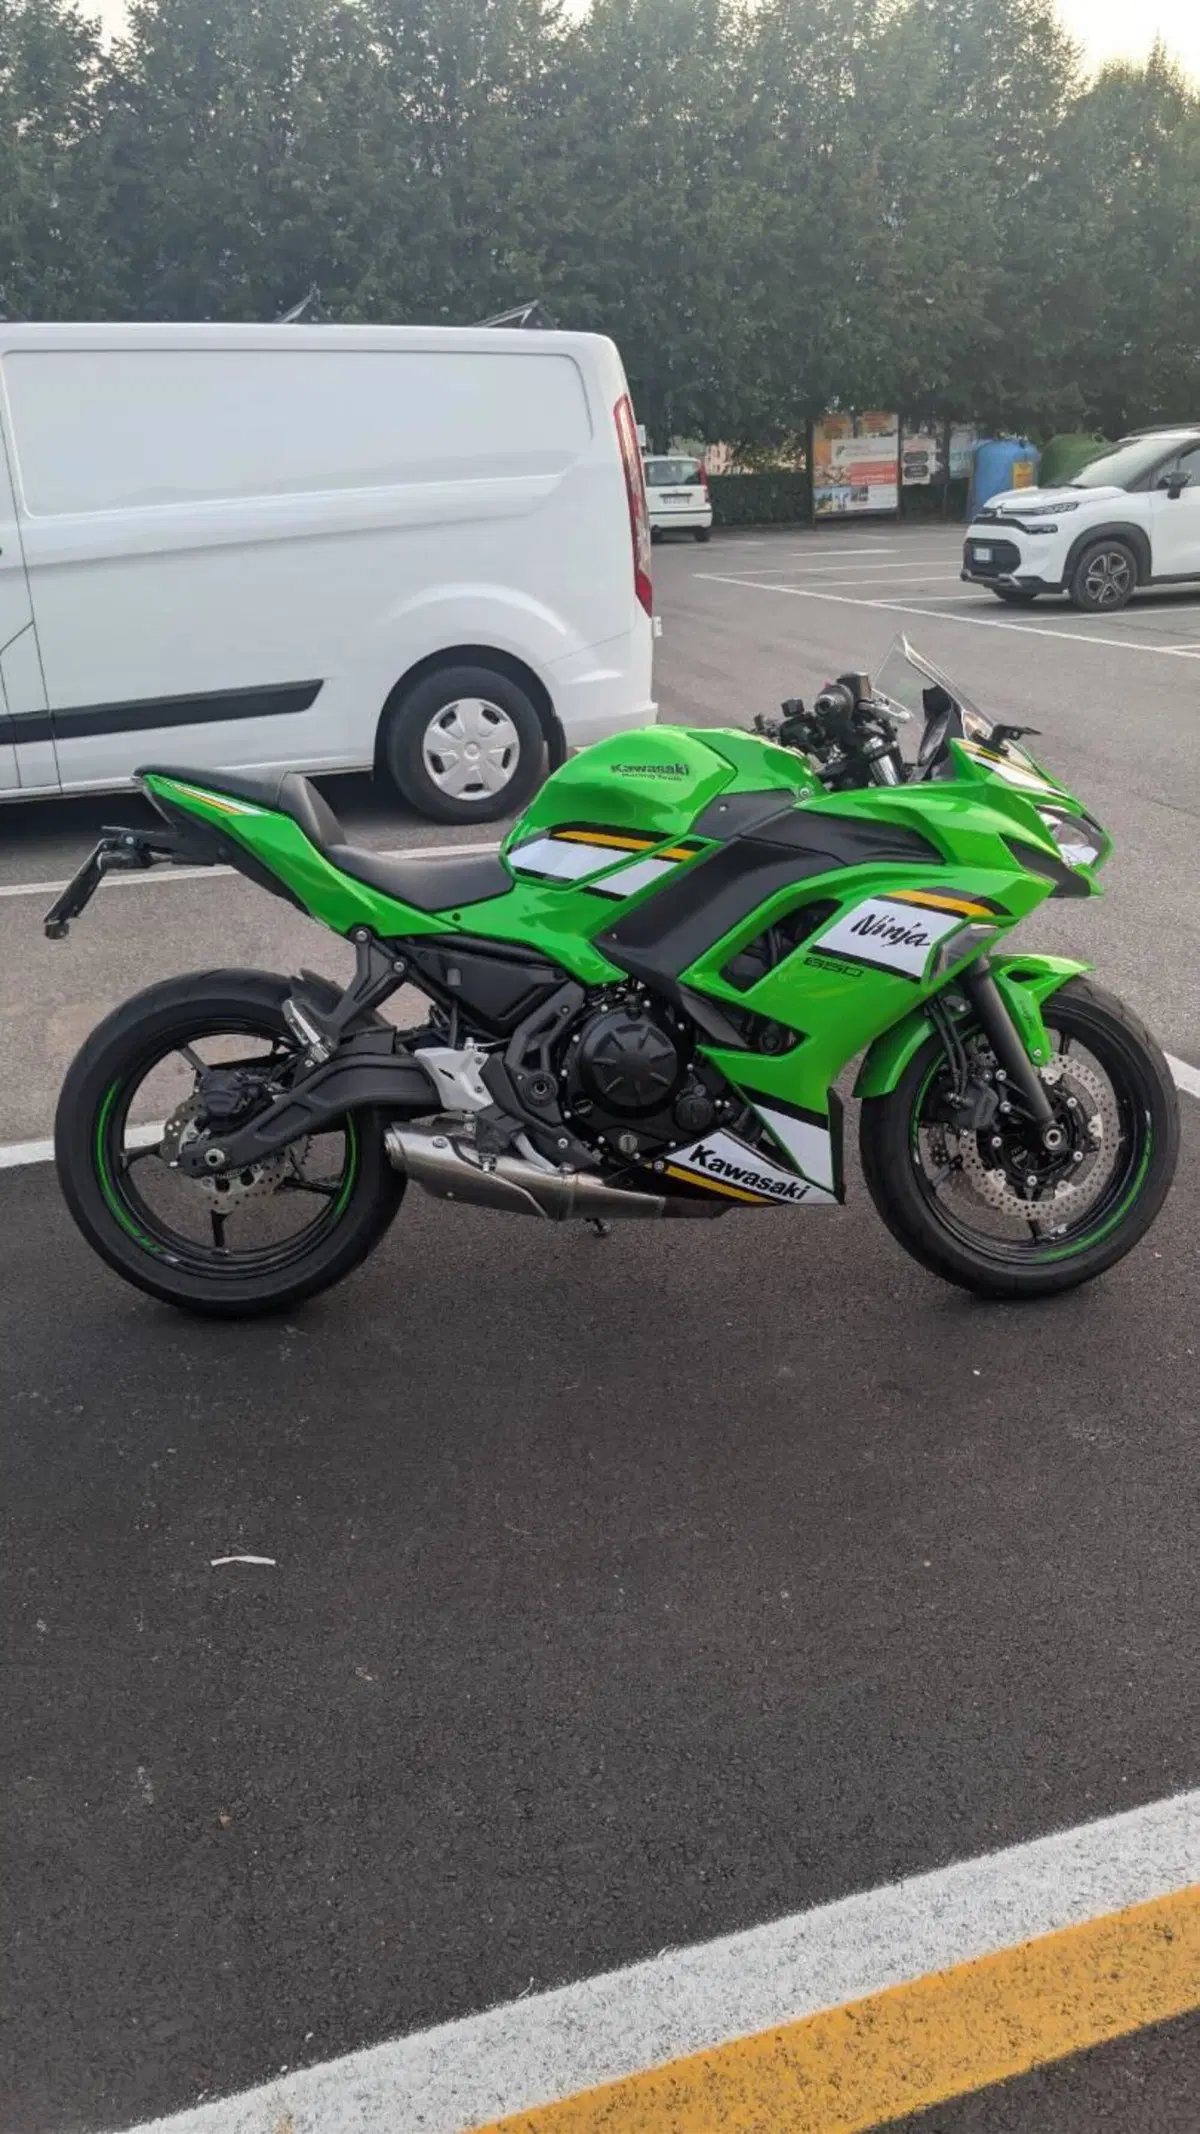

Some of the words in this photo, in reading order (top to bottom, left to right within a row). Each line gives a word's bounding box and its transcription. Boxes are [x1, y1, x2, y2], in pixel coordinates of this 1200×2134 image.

[611, 763, 689, 776] Kawasaki
[850, 913, 931, 948] Ninja
[803, 956, 865, 978] 650
[688, 1144, 811, 1200] Kawasaki
